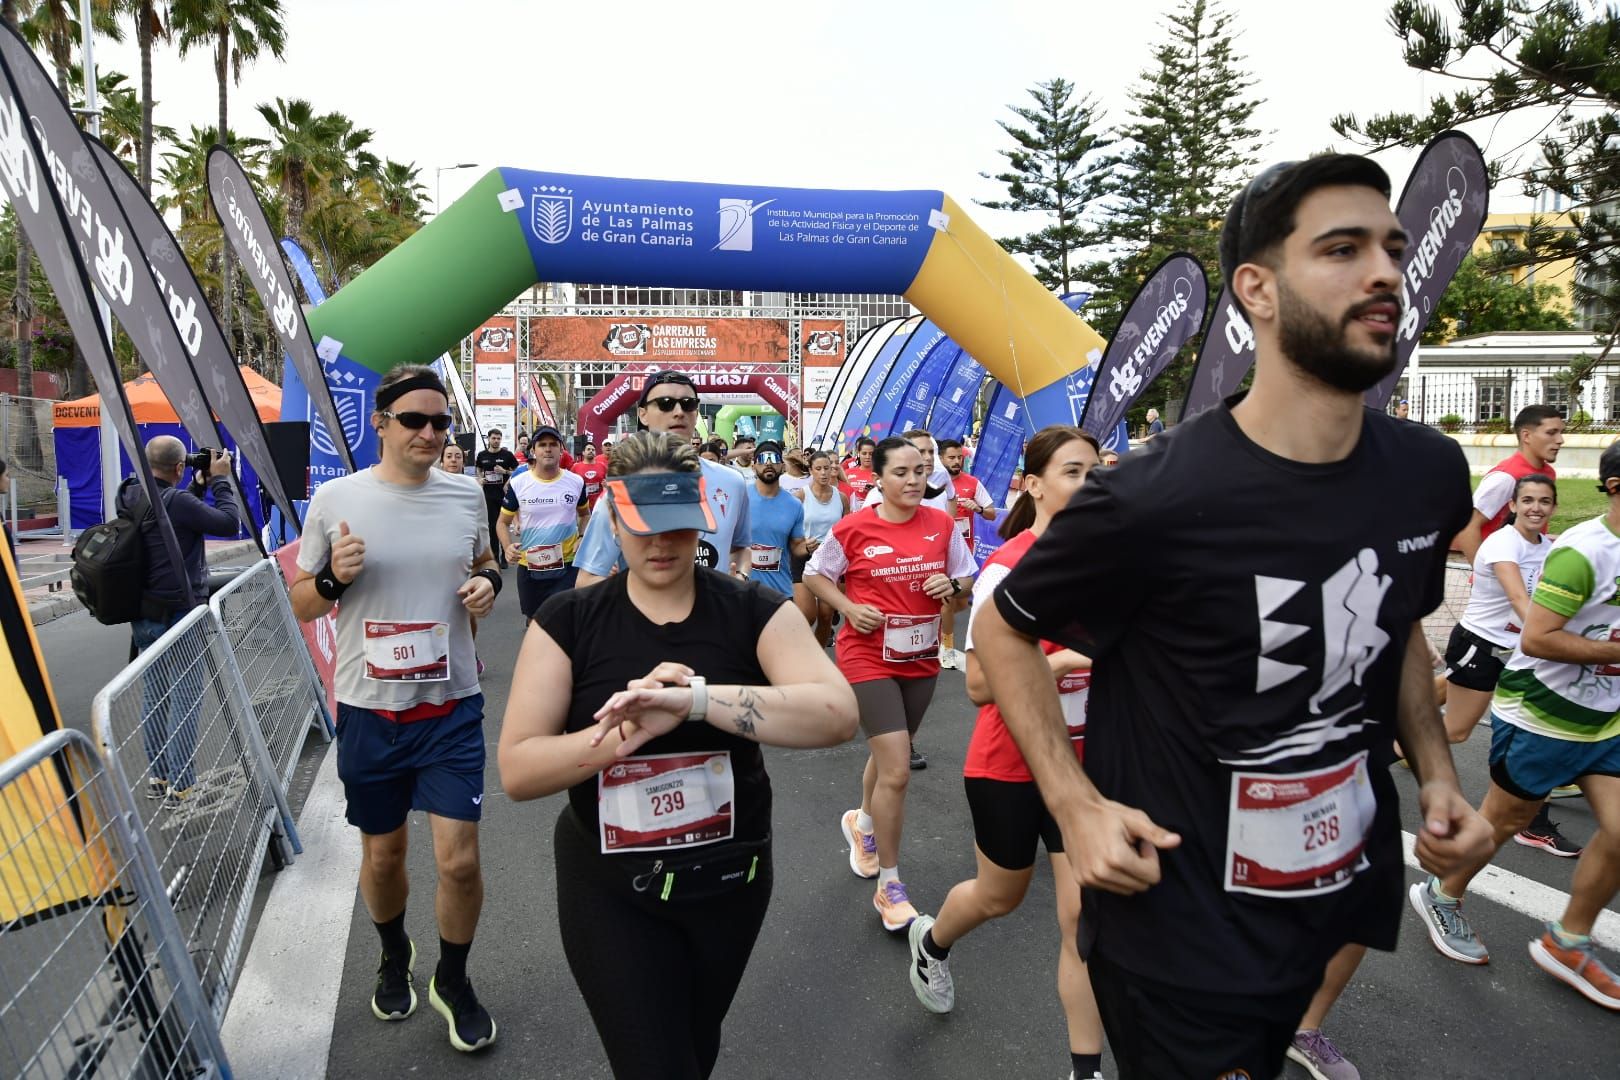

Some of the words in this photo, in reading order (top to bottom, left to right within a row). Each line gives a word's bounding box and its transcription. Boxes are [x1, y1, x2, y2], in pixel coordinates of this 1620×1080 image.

[582, 199, 694, 217] Ayuntamiento
[767, 208, 801, 218] Instituto
[803, 210, 844, 220] Municipal
[845, 213, 865, 221] para
[866, 212, 874, 220] la
[875, 212, 919, 221] Promoción
[581, 214, 601, 227] de
[609, 215, 633, 229] Las
[642, 217, 694, 232] Palmas
[768, 219, 780, 228] de
[781, 219, 790, 228] la
[791, 220, 830, 230] Actividad
[855, 223, 862, 233] y
[863, 222, 871, 231] el
[873, 223, 905, 233] Deporte
[907, 223, 919, 232] de
[581, 229, 600, 242] de
[602, 230, 637, 244] Gran
[640, 232, 694, 247] Canaria
[779, 232, 794, 242] Las
[797, 233, 829, 244] Palmas
[832, 233, 845, 244] de
[847, 235, 870, 245] Gran
[872, 234, 908, 245] Canaria
[1409, 187, 1463, 296] EVENTOS
[653, 325, 694, 337] CARRERA
[696, 325, 707, 337] DE
[1135, 291, 1189, 369] EVENTOS
[652, 337, 669, 349] LAS
[671, 337, 717, 349] EMPRESAS
[593, 376, 631, 416] Canarias7
[55, 406, 100, 418] DGEVENT
[871, 566, 900, 577] CARRERA
[900, 565, 909, 573] DE
[908, 563, 921, 572] LAS
[910, 634, 924, 646] 121
[393, 644, 415, 661] 501
[651, 791, 685, 817] 239
[1303, 815, 1340, 852] 238
